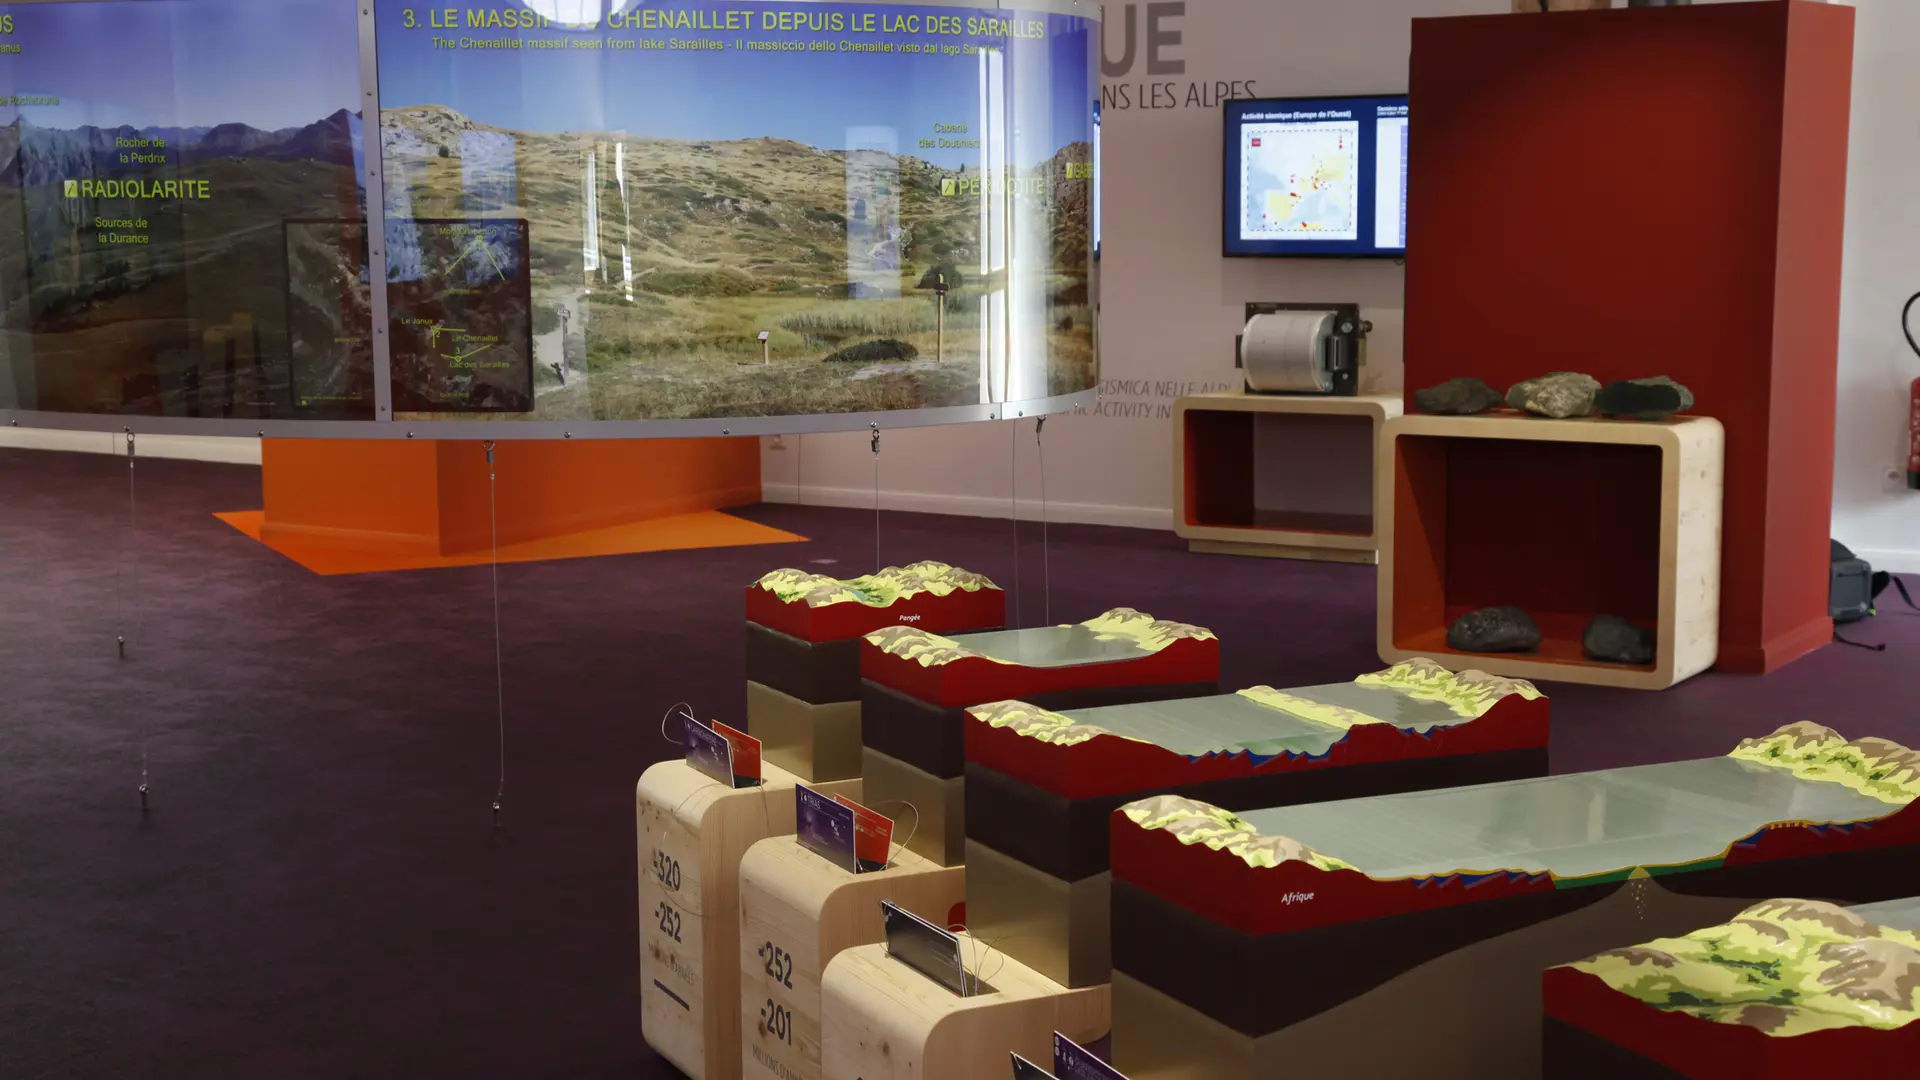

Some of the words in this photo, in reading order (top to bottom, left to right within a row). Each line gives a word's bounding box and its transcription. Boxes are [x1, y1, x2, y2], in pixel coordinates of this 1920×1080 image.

[0, 15, 13, 33] S
[402, 9, 422, 28] 3.
[430, 9, 458, 28] LE
[607, 10, 753, 30] CHENAILLET
[762, 11, 844, 31] DEPUIS
[851, 14, 876, 33] LE
[883, 15, 920, 34] LAC
[926, 16, 962, 35] DES
[967, 17, 1044, 39] SARAILLES
[0, 43, 21, 53] anus
[432, 37, 456, 49] The
[459, 37, 523, 49] Chenaillet
[527, 37, 569, 49] massif
[572, 39, 603, 49] seen
[607, 37, 635, 49] from
[640, 38, 665, 49] lake
[669, 38, 723, 50] Sarailles
[747, 40, 805, 51] massiccio
[809, 40, 836, 52] dello
[839, 41, 894, 53] Chenaillet
[898, 42, 920, 53] visto
[923, 43, 938, 54] dal
[941, 43, 960, 56] lago
[1140, 82, 1177, 109] LES
[1185, 80, 1257, 109] ALPES
[933, 122, 967, 133] Cabane
[116, 137, 150, 149] Rocher
[152, 137, 165, 149] de
[919, 138, 935, 149] des
[120, 153, 128, 164] la
[130, 153, 166, 164] Perdrix
[81, 180, 211, 199] RADIOLARITE
[95, 217, 132, 229] Sources
[135, 217, 148, 229] de
[98, 233, 107, 244] la
[109, 233, 149, 244] Durance
[1094, 401, 1152, 418] ACTIVITY
[1156, 403, 1171, 419] IN
[653, 851, 680, 891] -320
[1281, 891, 1315, 906] Afrique
[655, 901, 682, 944] -252
[758, 941, 793, 990] -252
[761, 998, 792, 1046] -201
